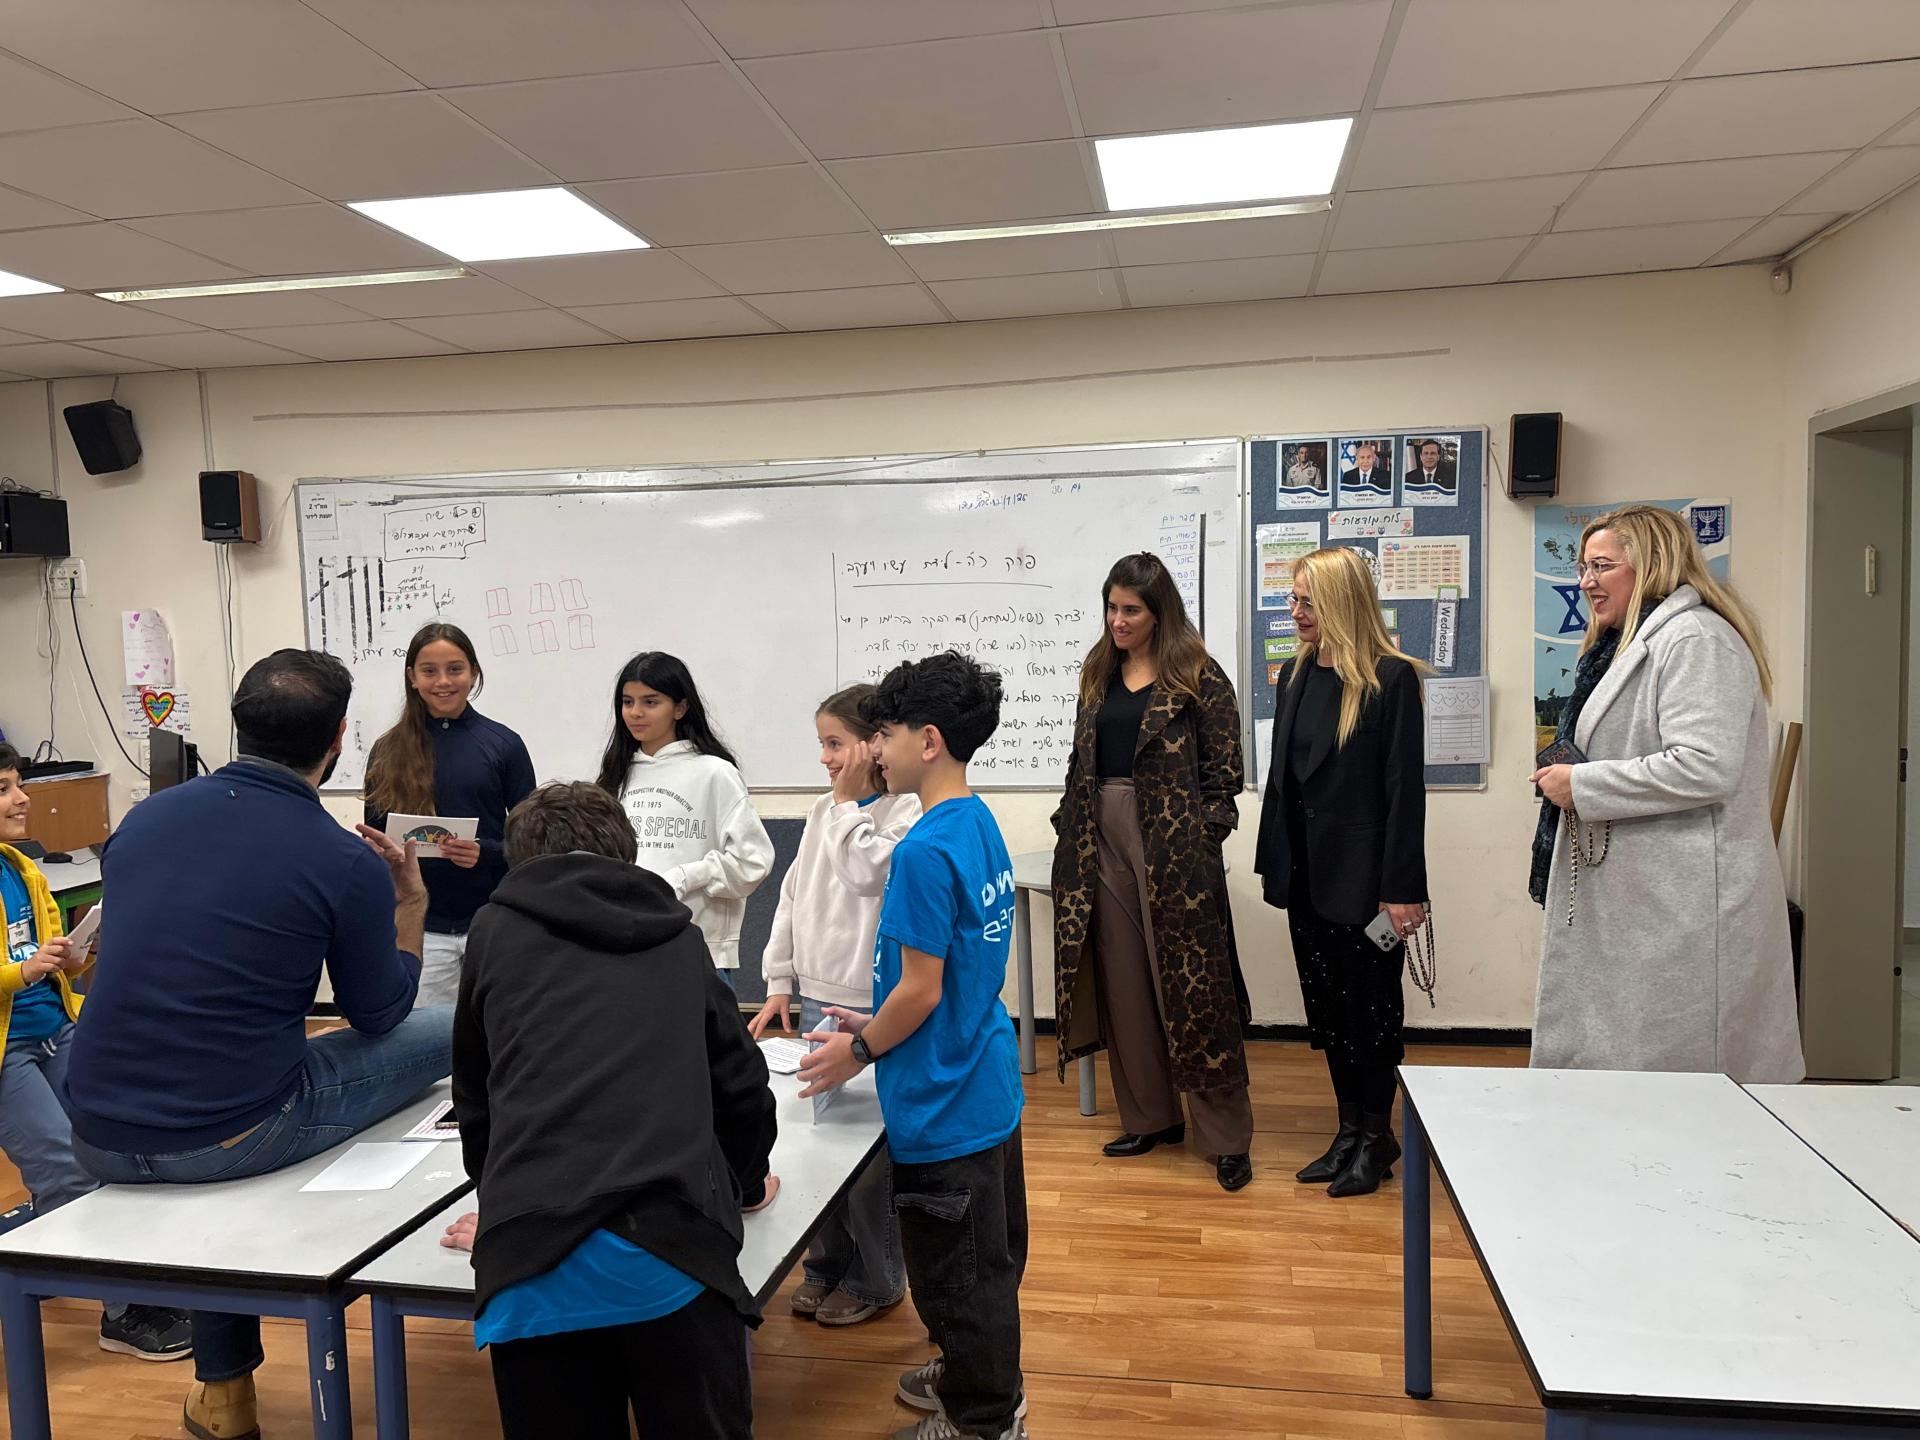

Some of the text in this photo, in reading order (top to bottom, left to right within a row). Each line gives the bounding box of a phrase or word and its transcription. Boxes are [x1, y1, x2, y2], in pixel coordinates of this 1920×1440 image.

[1341, 511, 1401, 527] לוח מודעות
[1004, 553, 1036, 573] פרק
[1054, 609, 1085, 626] יצחק
[1436, 606, 1452, 664] Wednesday
[1272, 644, 1293, 652] Today
[628, 787, 655, 796] PERSPECTIVE
[656, 787, 675, 797] ANOTHER
[674, 794, 694, 812] OBJECTIVE
[648, 801, 662, 809] 1975
[644, 816, 707, 839] SPECIAL
